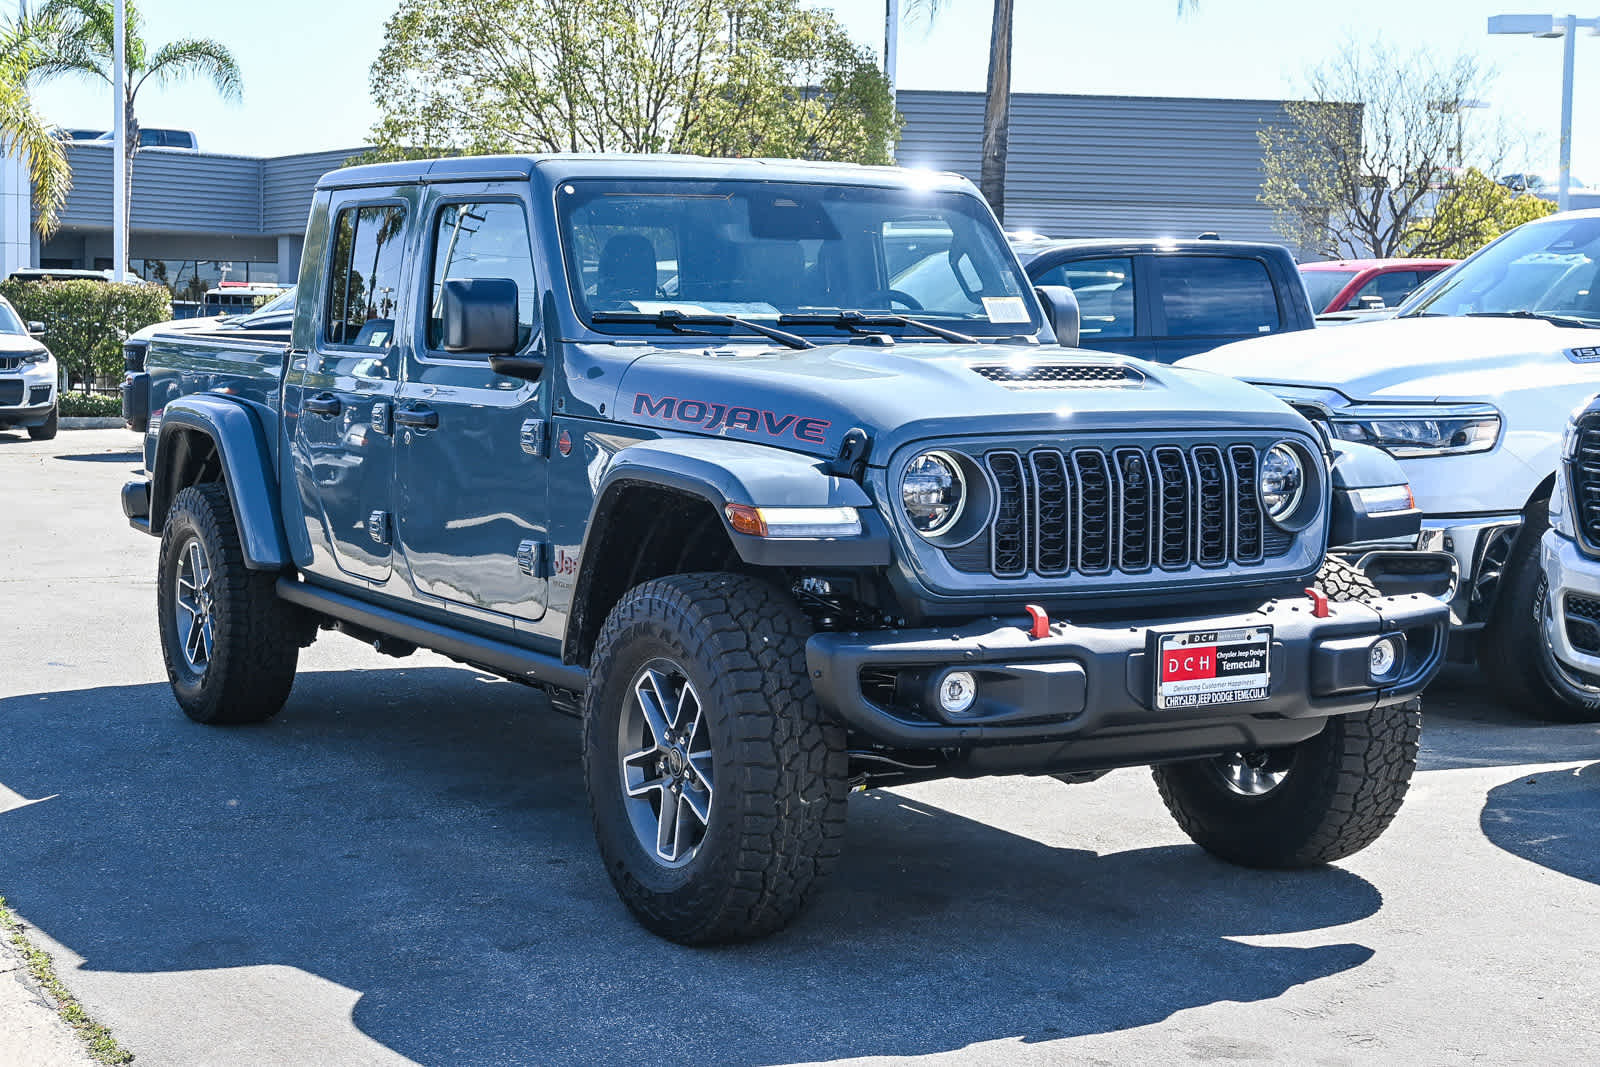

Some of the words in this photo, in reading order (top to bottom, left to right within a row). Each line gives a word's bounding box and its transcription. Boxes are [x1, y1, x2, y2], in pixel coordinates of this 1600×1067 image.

[632, 392, 832, 444] MOJAVE
[1216, 650, 1237, 660] Chrysler
[1237, 650, 1249, 658] Jeep
[1249, 649, 1266, 657] Dodge
[1222, 658, 1261, 671] Temecula
[1165, 694, 1197, 707] CHRYSLER
[1197, 693, 1212, 705] JEEP
[1212, 691, 1234, 703] DODGE
